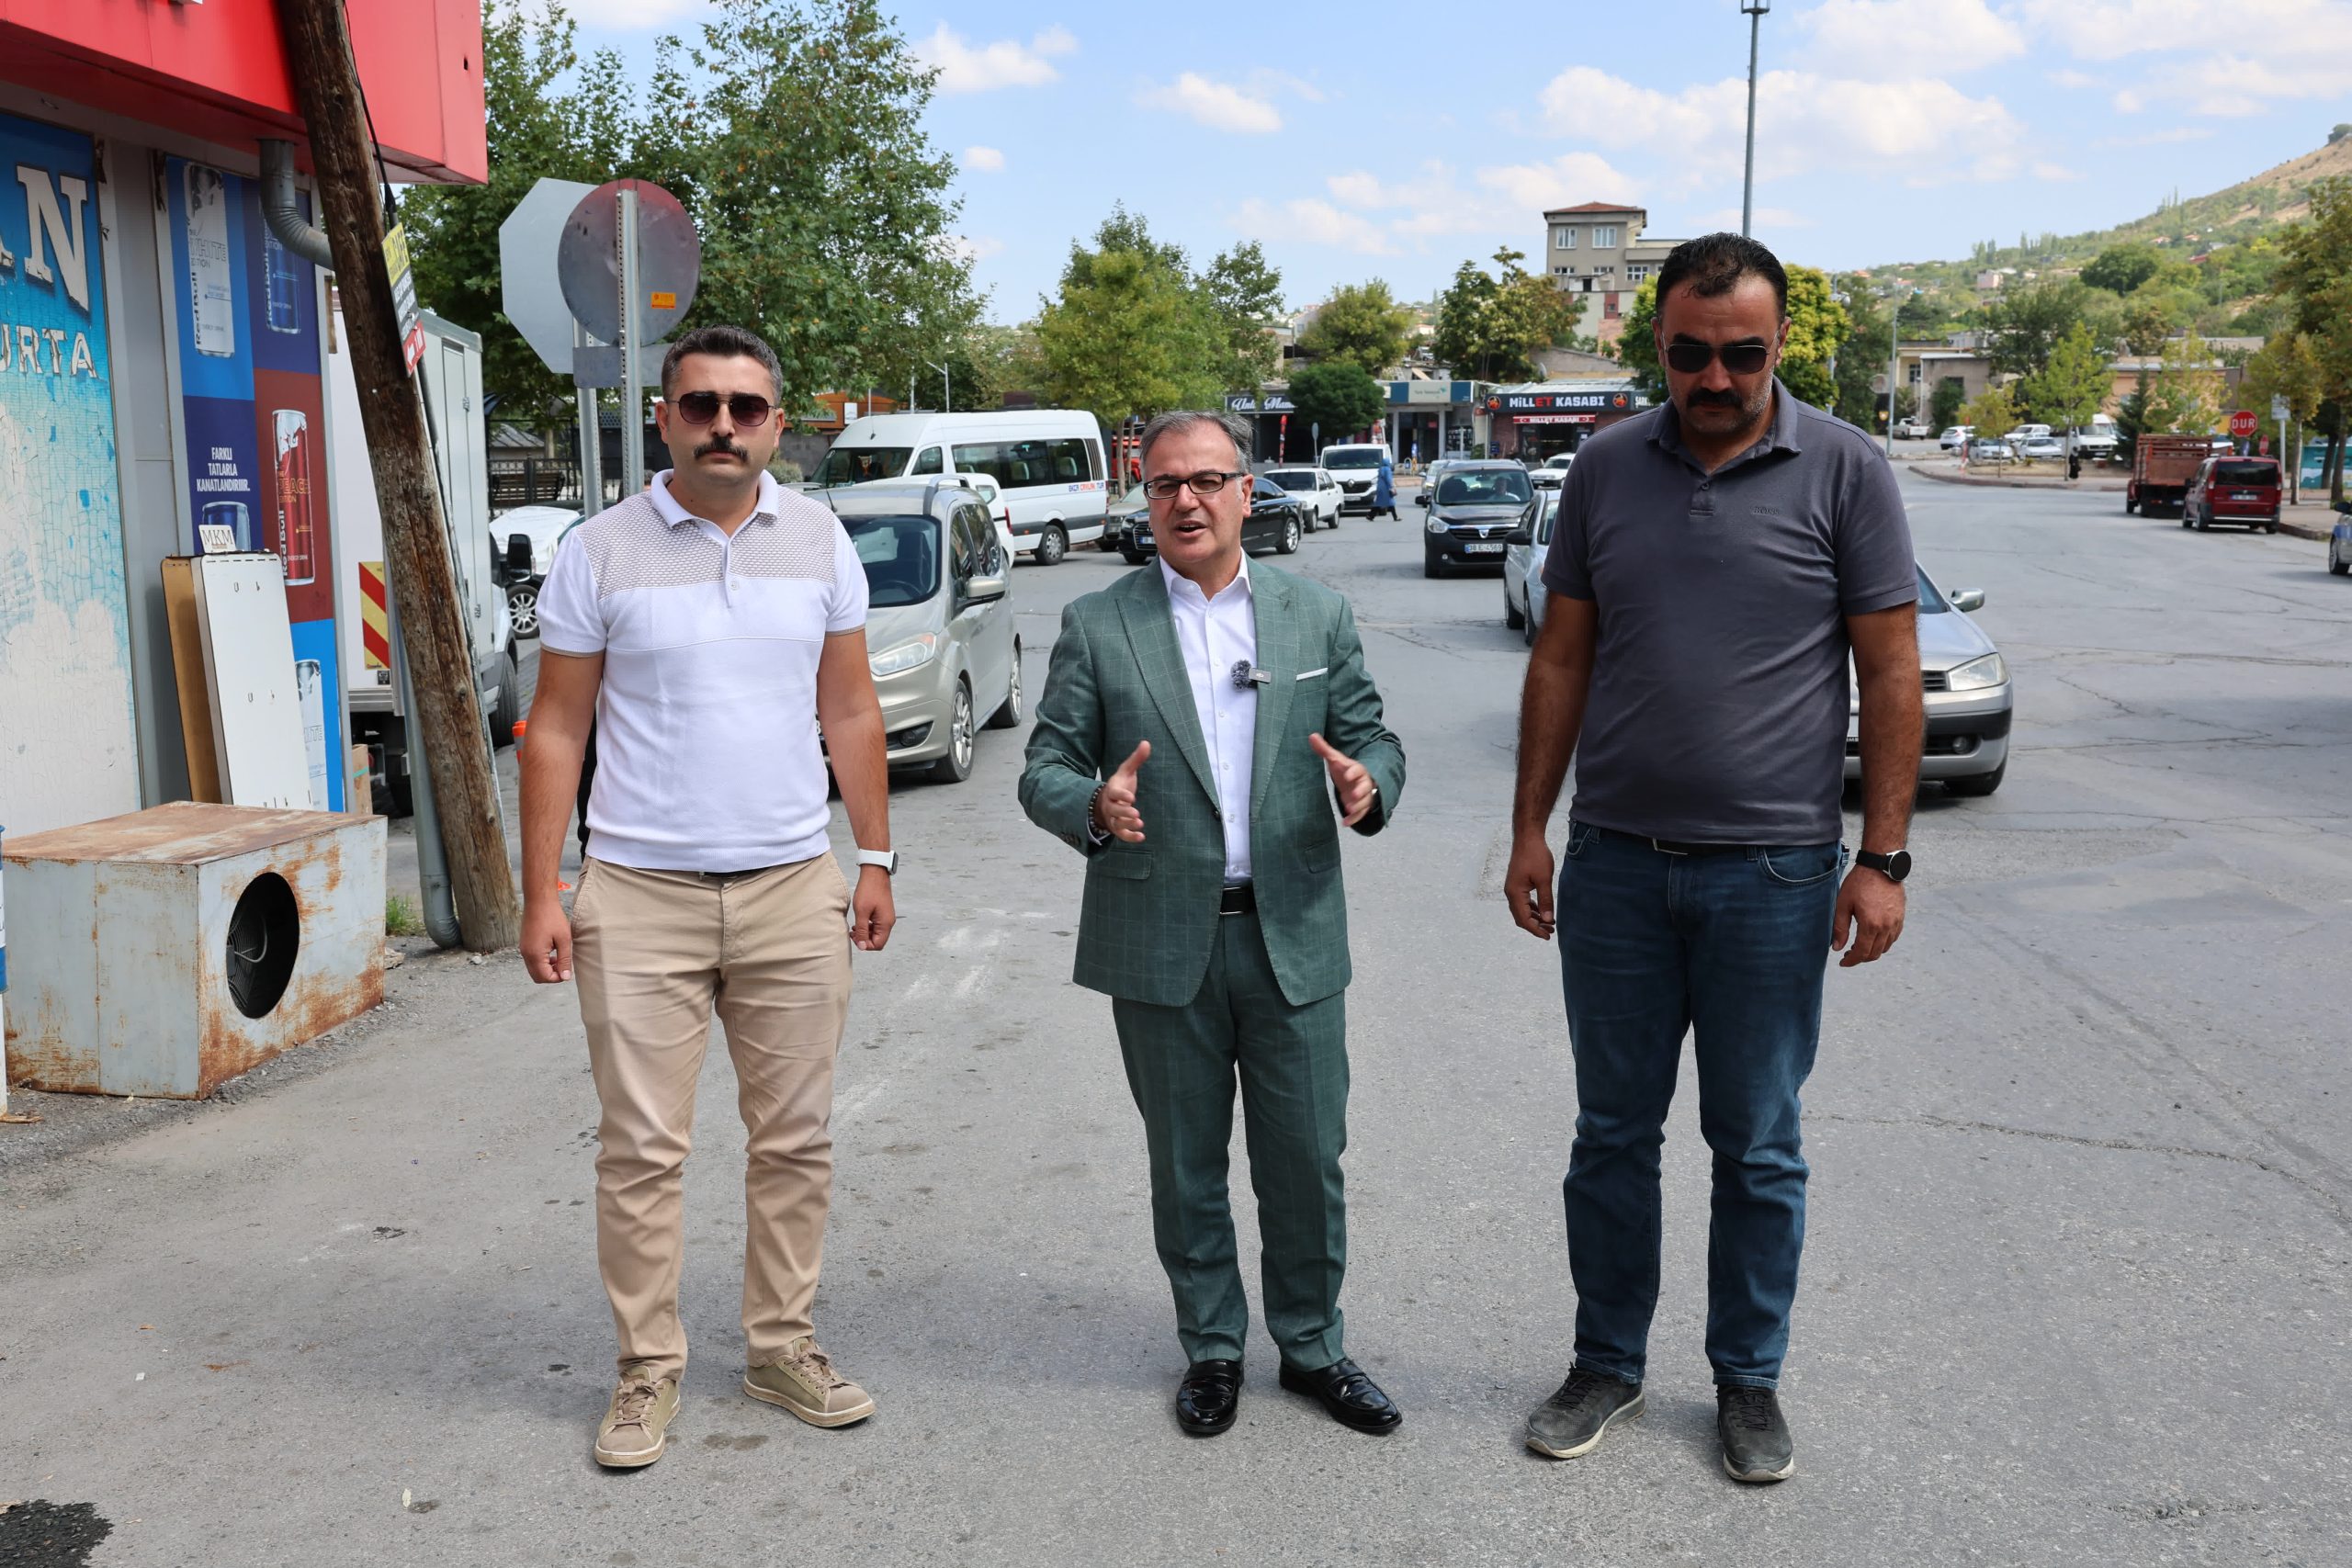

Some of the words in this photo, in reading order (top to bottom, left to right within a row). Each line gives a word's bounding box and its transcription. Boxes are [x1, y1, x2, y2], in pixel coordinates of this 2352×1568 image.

[1555, 396, 1605, 407] KASABI
[2232, 418, 2256, 429] DUR
[211, 447, 232, 460] FARKLI
[208, 463, 238, 476] TATLARLA
[202, 530, 232, 545] MKM
